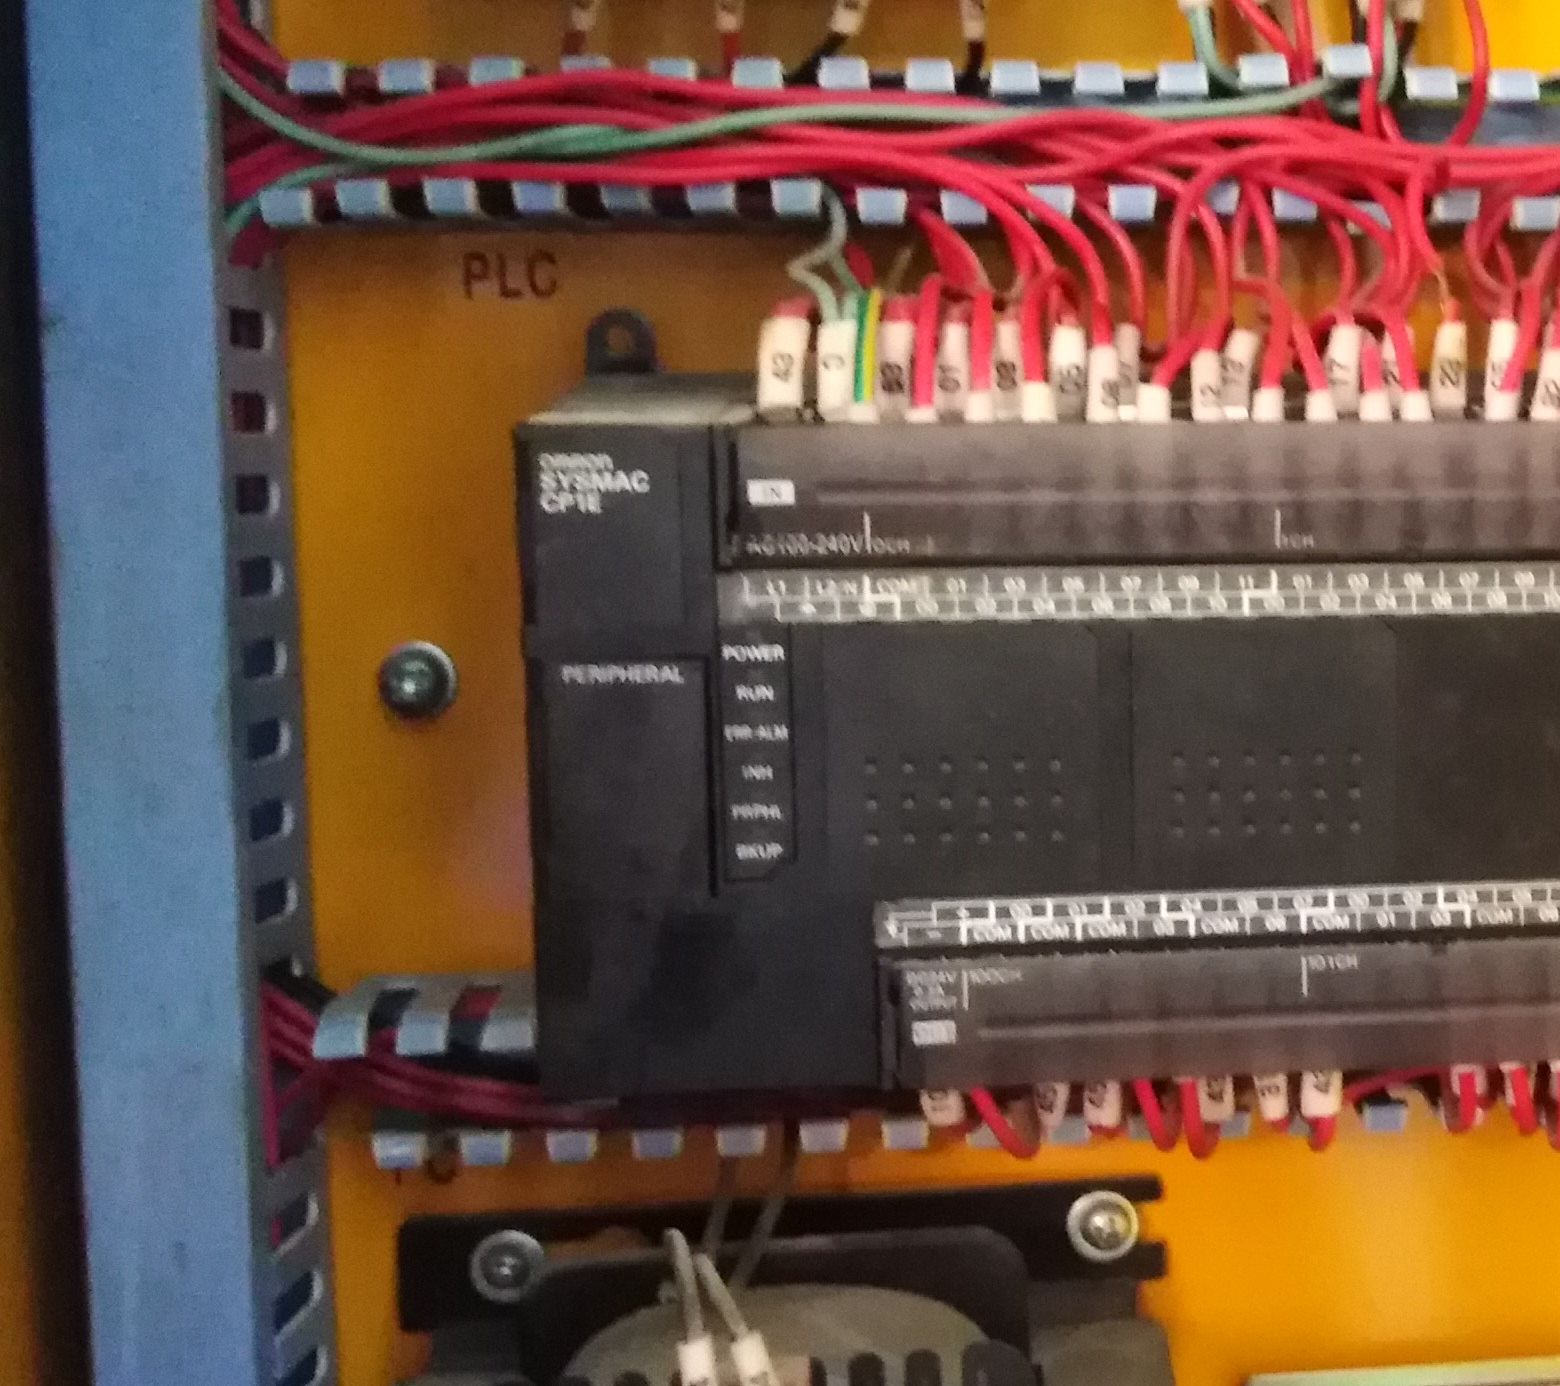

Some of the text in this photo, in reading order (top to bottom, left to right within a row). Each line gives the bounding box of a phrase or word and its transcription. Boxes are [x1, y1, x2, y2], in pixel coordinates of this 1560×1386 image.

[463, 250, 557, 301] PLC
[539, 470, 651, 494] SYSMAC
[540, 492, 602, 514] CP1E
[721, 643, 787, 663] POWER
[560, 664, 685, 685] PERIPHERAL
[734, 684, 775, 702] RUN
[735, 842, 784, 861] BKUP
